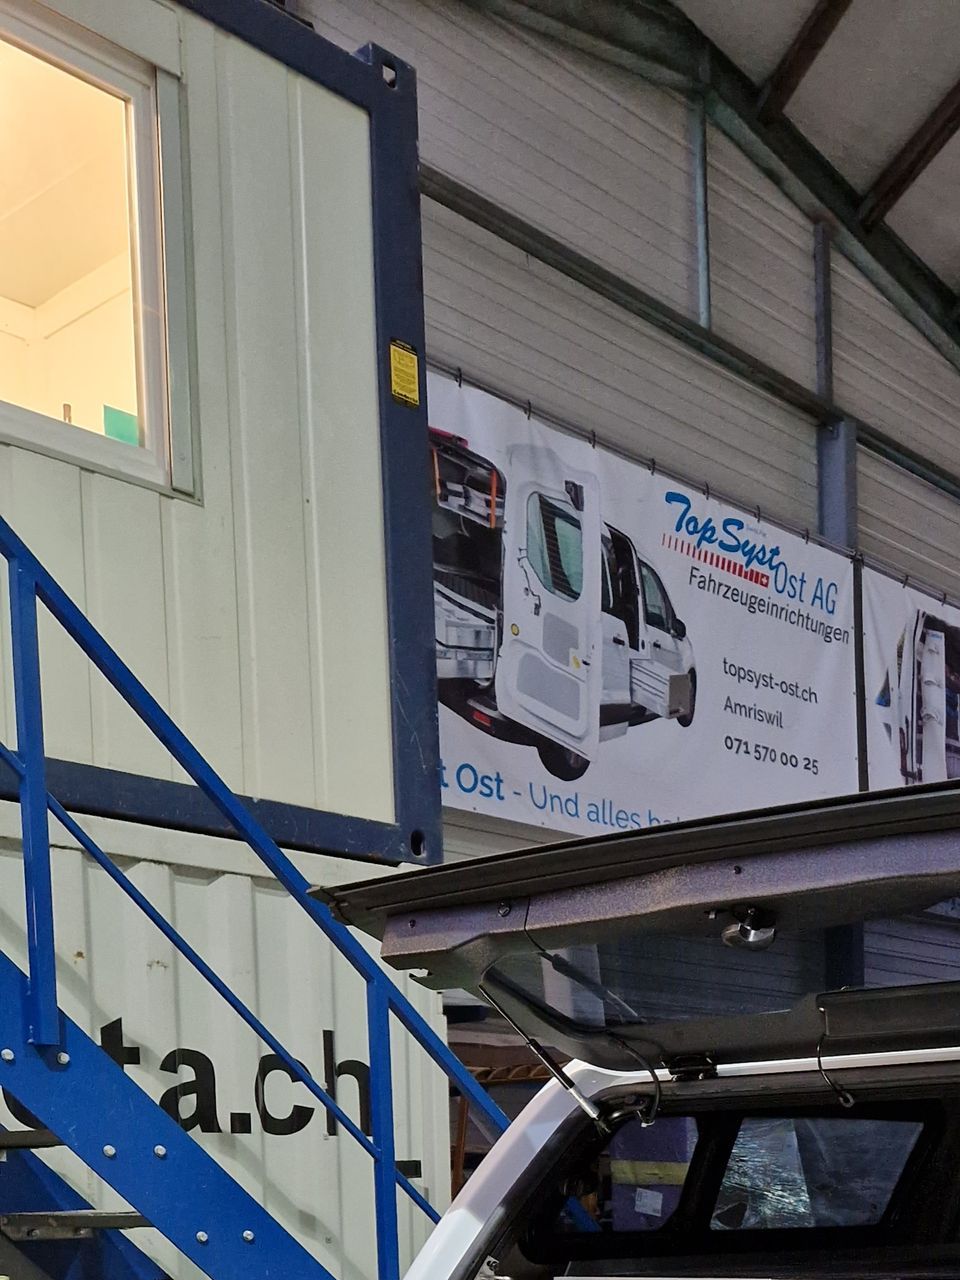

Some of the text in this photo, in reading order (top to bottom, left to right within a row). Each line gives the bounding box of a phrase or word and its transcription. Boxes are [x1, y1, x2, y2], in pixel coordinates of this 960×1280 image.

[665, 491, 838, 615] TopSyst Ost AG
[689, 566, 850, 644] Fahrzeugeinrichtungen
[723, 657, 818, 704] topsyst-ost.ch
[723, 695, 784, 728] Amriswil
[724, 735, 819, 776] 071 570 00 25
[455, 762, 505, 801] Ost
[529, 782, 580, 819] Und
